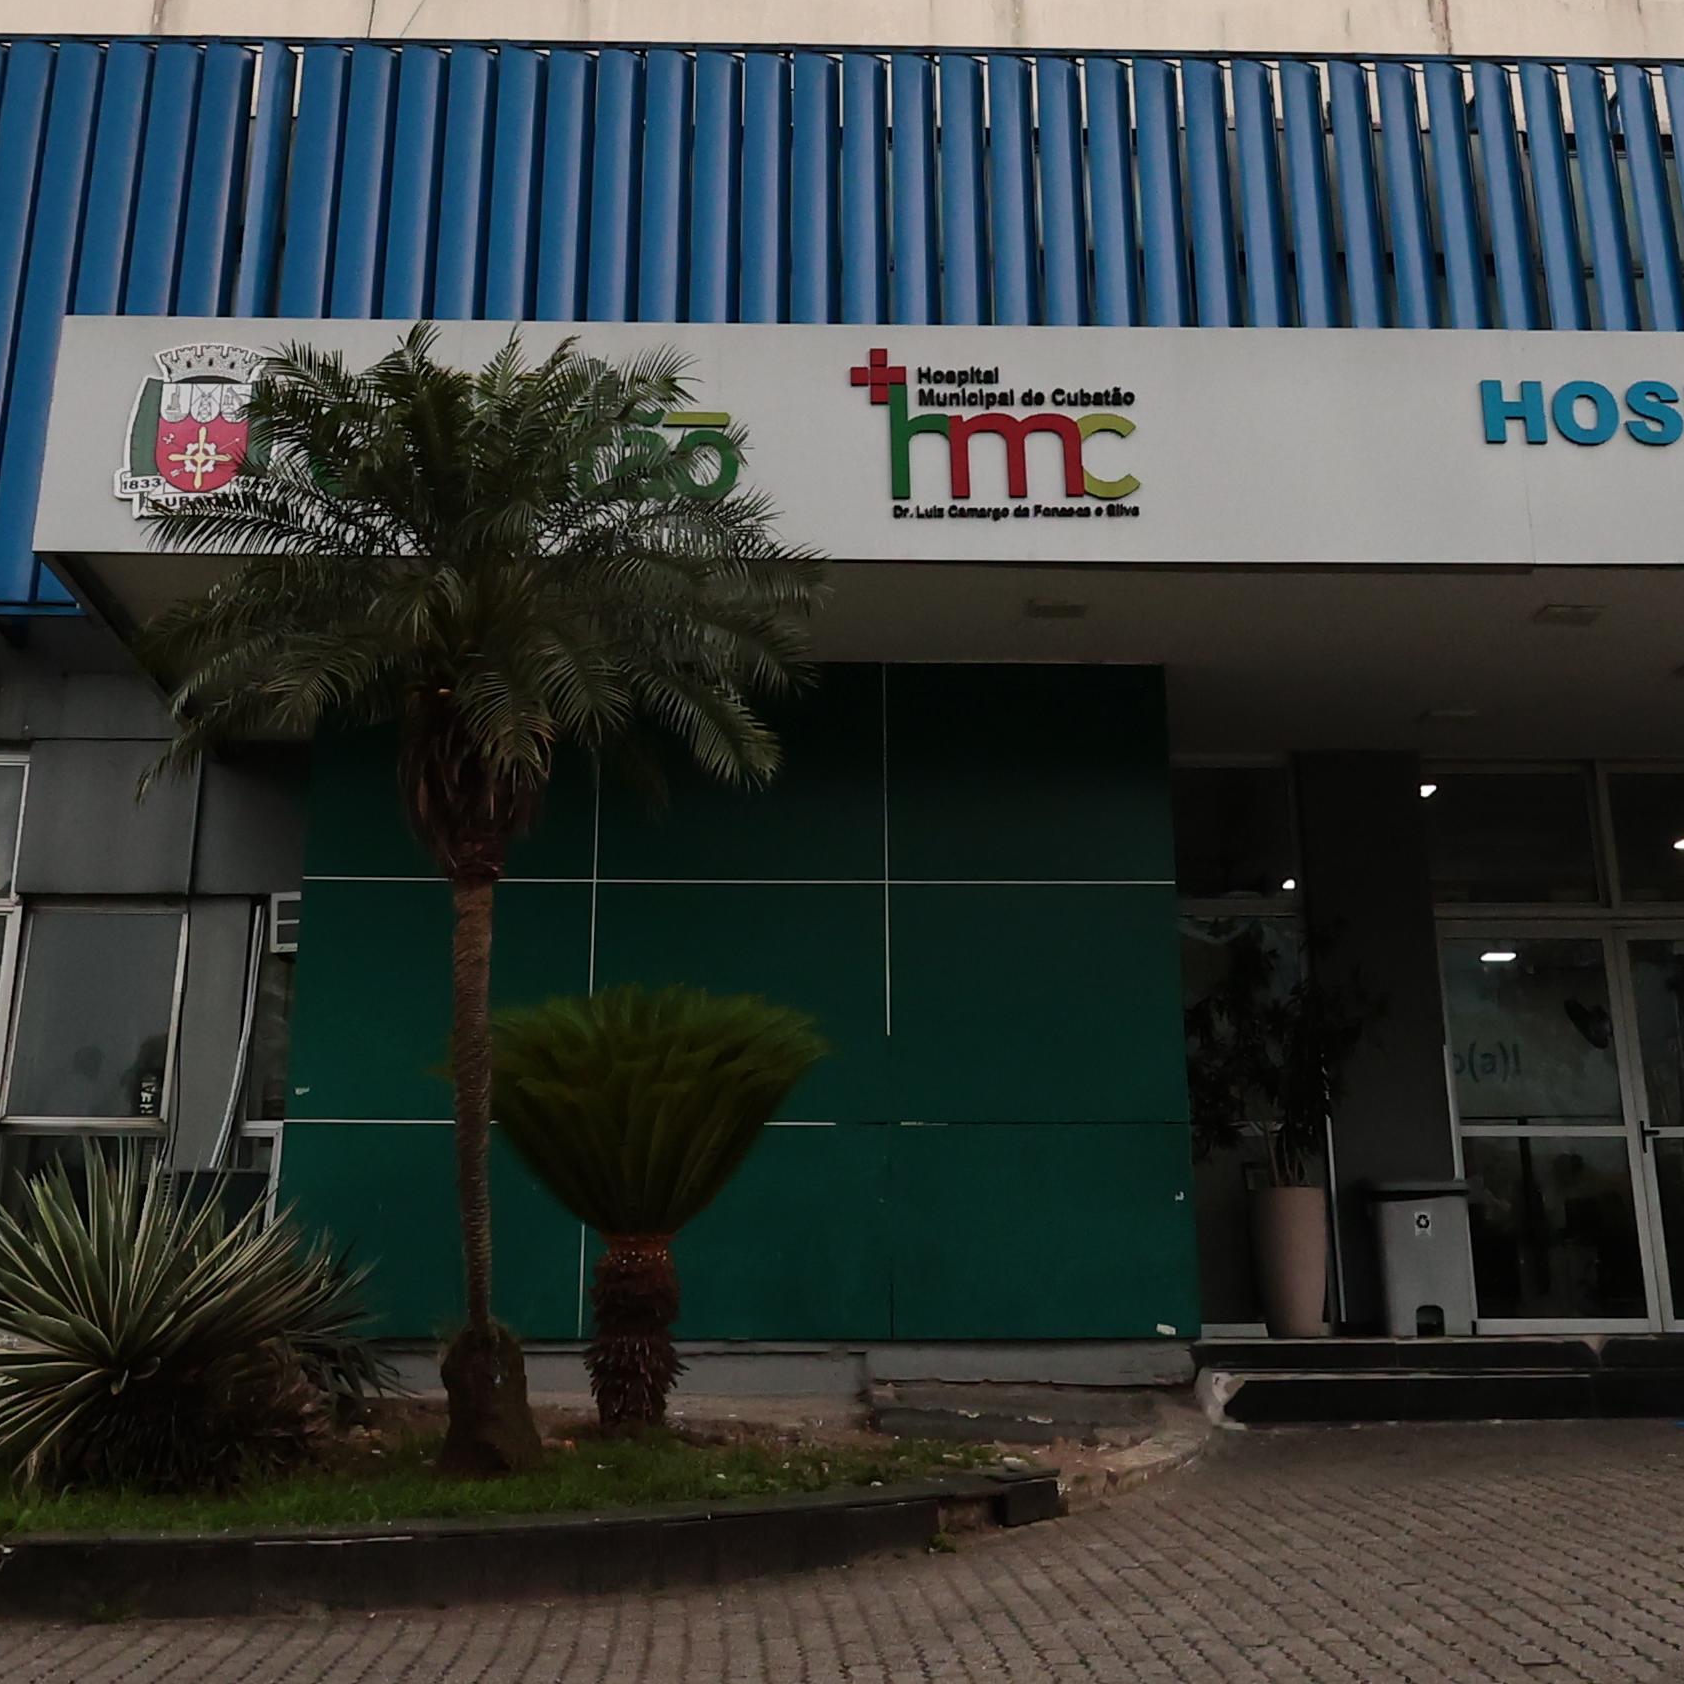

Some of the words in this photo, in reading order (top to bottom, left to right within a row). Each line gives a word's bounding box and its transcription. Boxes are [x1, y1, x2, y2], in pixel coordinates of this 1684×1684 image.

[917, 366, 999, 387] Hospital
[918, 388, 1015, 409] Municipal
[1021, 389, 1045, 406] de
[1051, 387, 1136, 406] Cubatão
[889, 383, 1141, 500] hmc
[123, 477, 161, 490] 1833
[893, 504, 914, 518] Dr.
